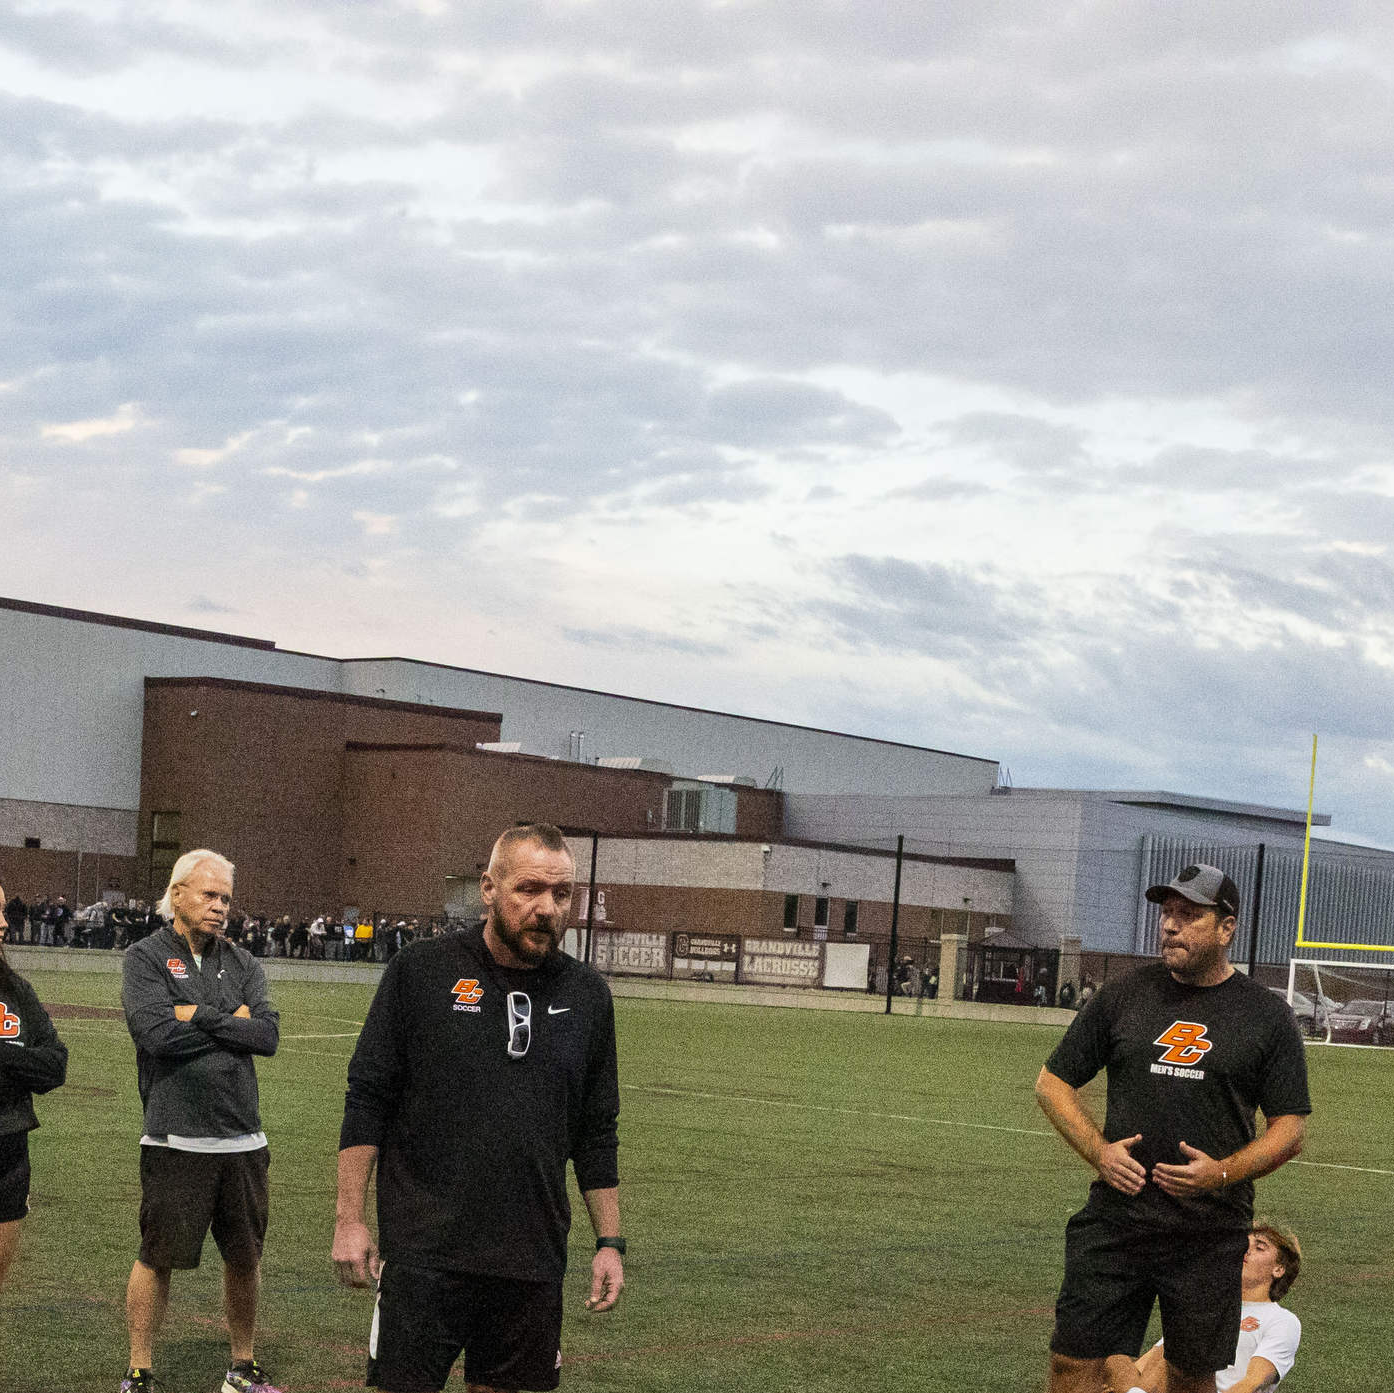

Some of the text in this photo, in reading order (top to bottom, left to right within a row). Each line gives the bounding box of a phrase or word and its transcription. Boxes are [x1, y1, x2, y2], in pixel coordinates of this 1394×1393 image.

[596, 944, 665, 968] SOCCER
[742, 954, 819, 977] LACROSSE
[452, 1003, 481, 1012] SOCCER
[1150, 1063, 1205, 1080] MEN'S SOCCER
